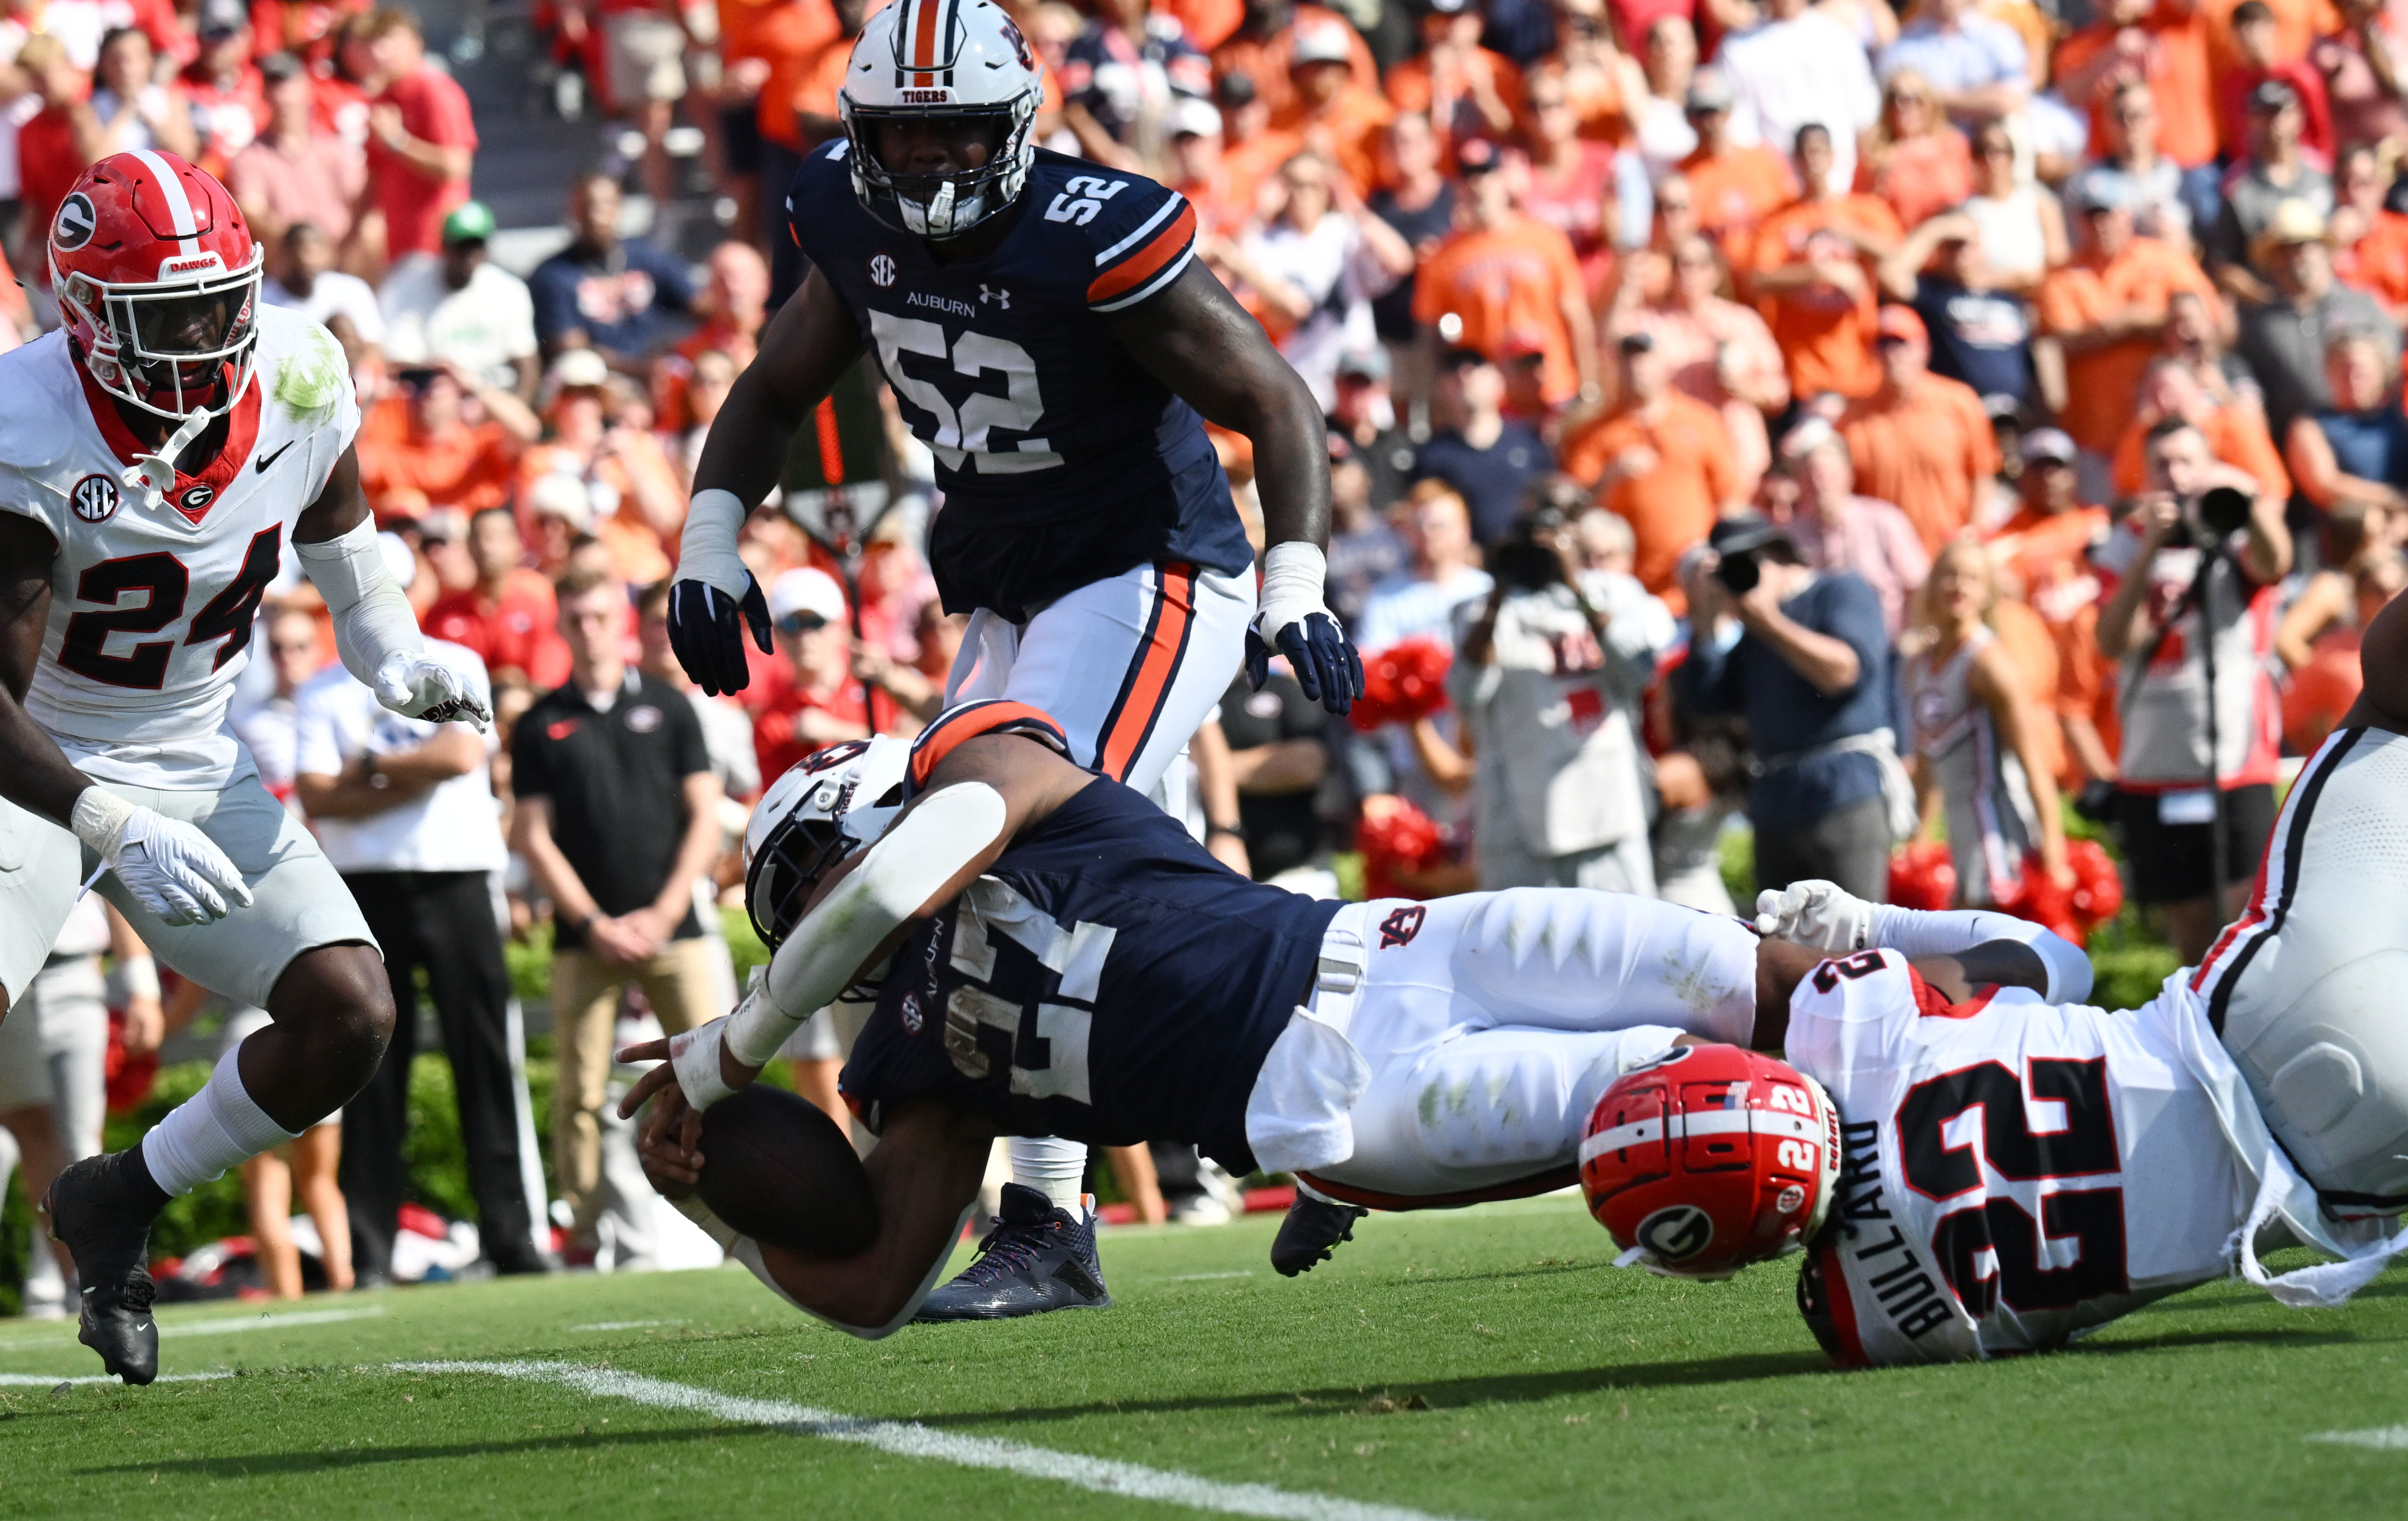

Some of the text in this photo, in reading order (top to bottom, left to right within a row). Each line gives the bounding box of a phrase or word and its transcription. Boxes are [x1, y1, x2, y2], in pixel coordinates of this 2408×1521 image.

[902, 90, 947, 103] TIGERS
[1044, 176, 1130, 226] 52
[170, 257, 217, 272] DAWGS
[870, 254, 896, 287] SEC
[906, 291, 976, 318] AUBURN
[867, 307, 1066, 475] 52
[75, 478, 115, 520] SEC
[56, 520, 283, 690] 24
[902, 994, 924, 1032] SEC
[1770, 1084, 1815, 1172] 22
[1895, 1055, 2129, 1319] 22
[1842, 1120, 1954, 1340] BULLARD
